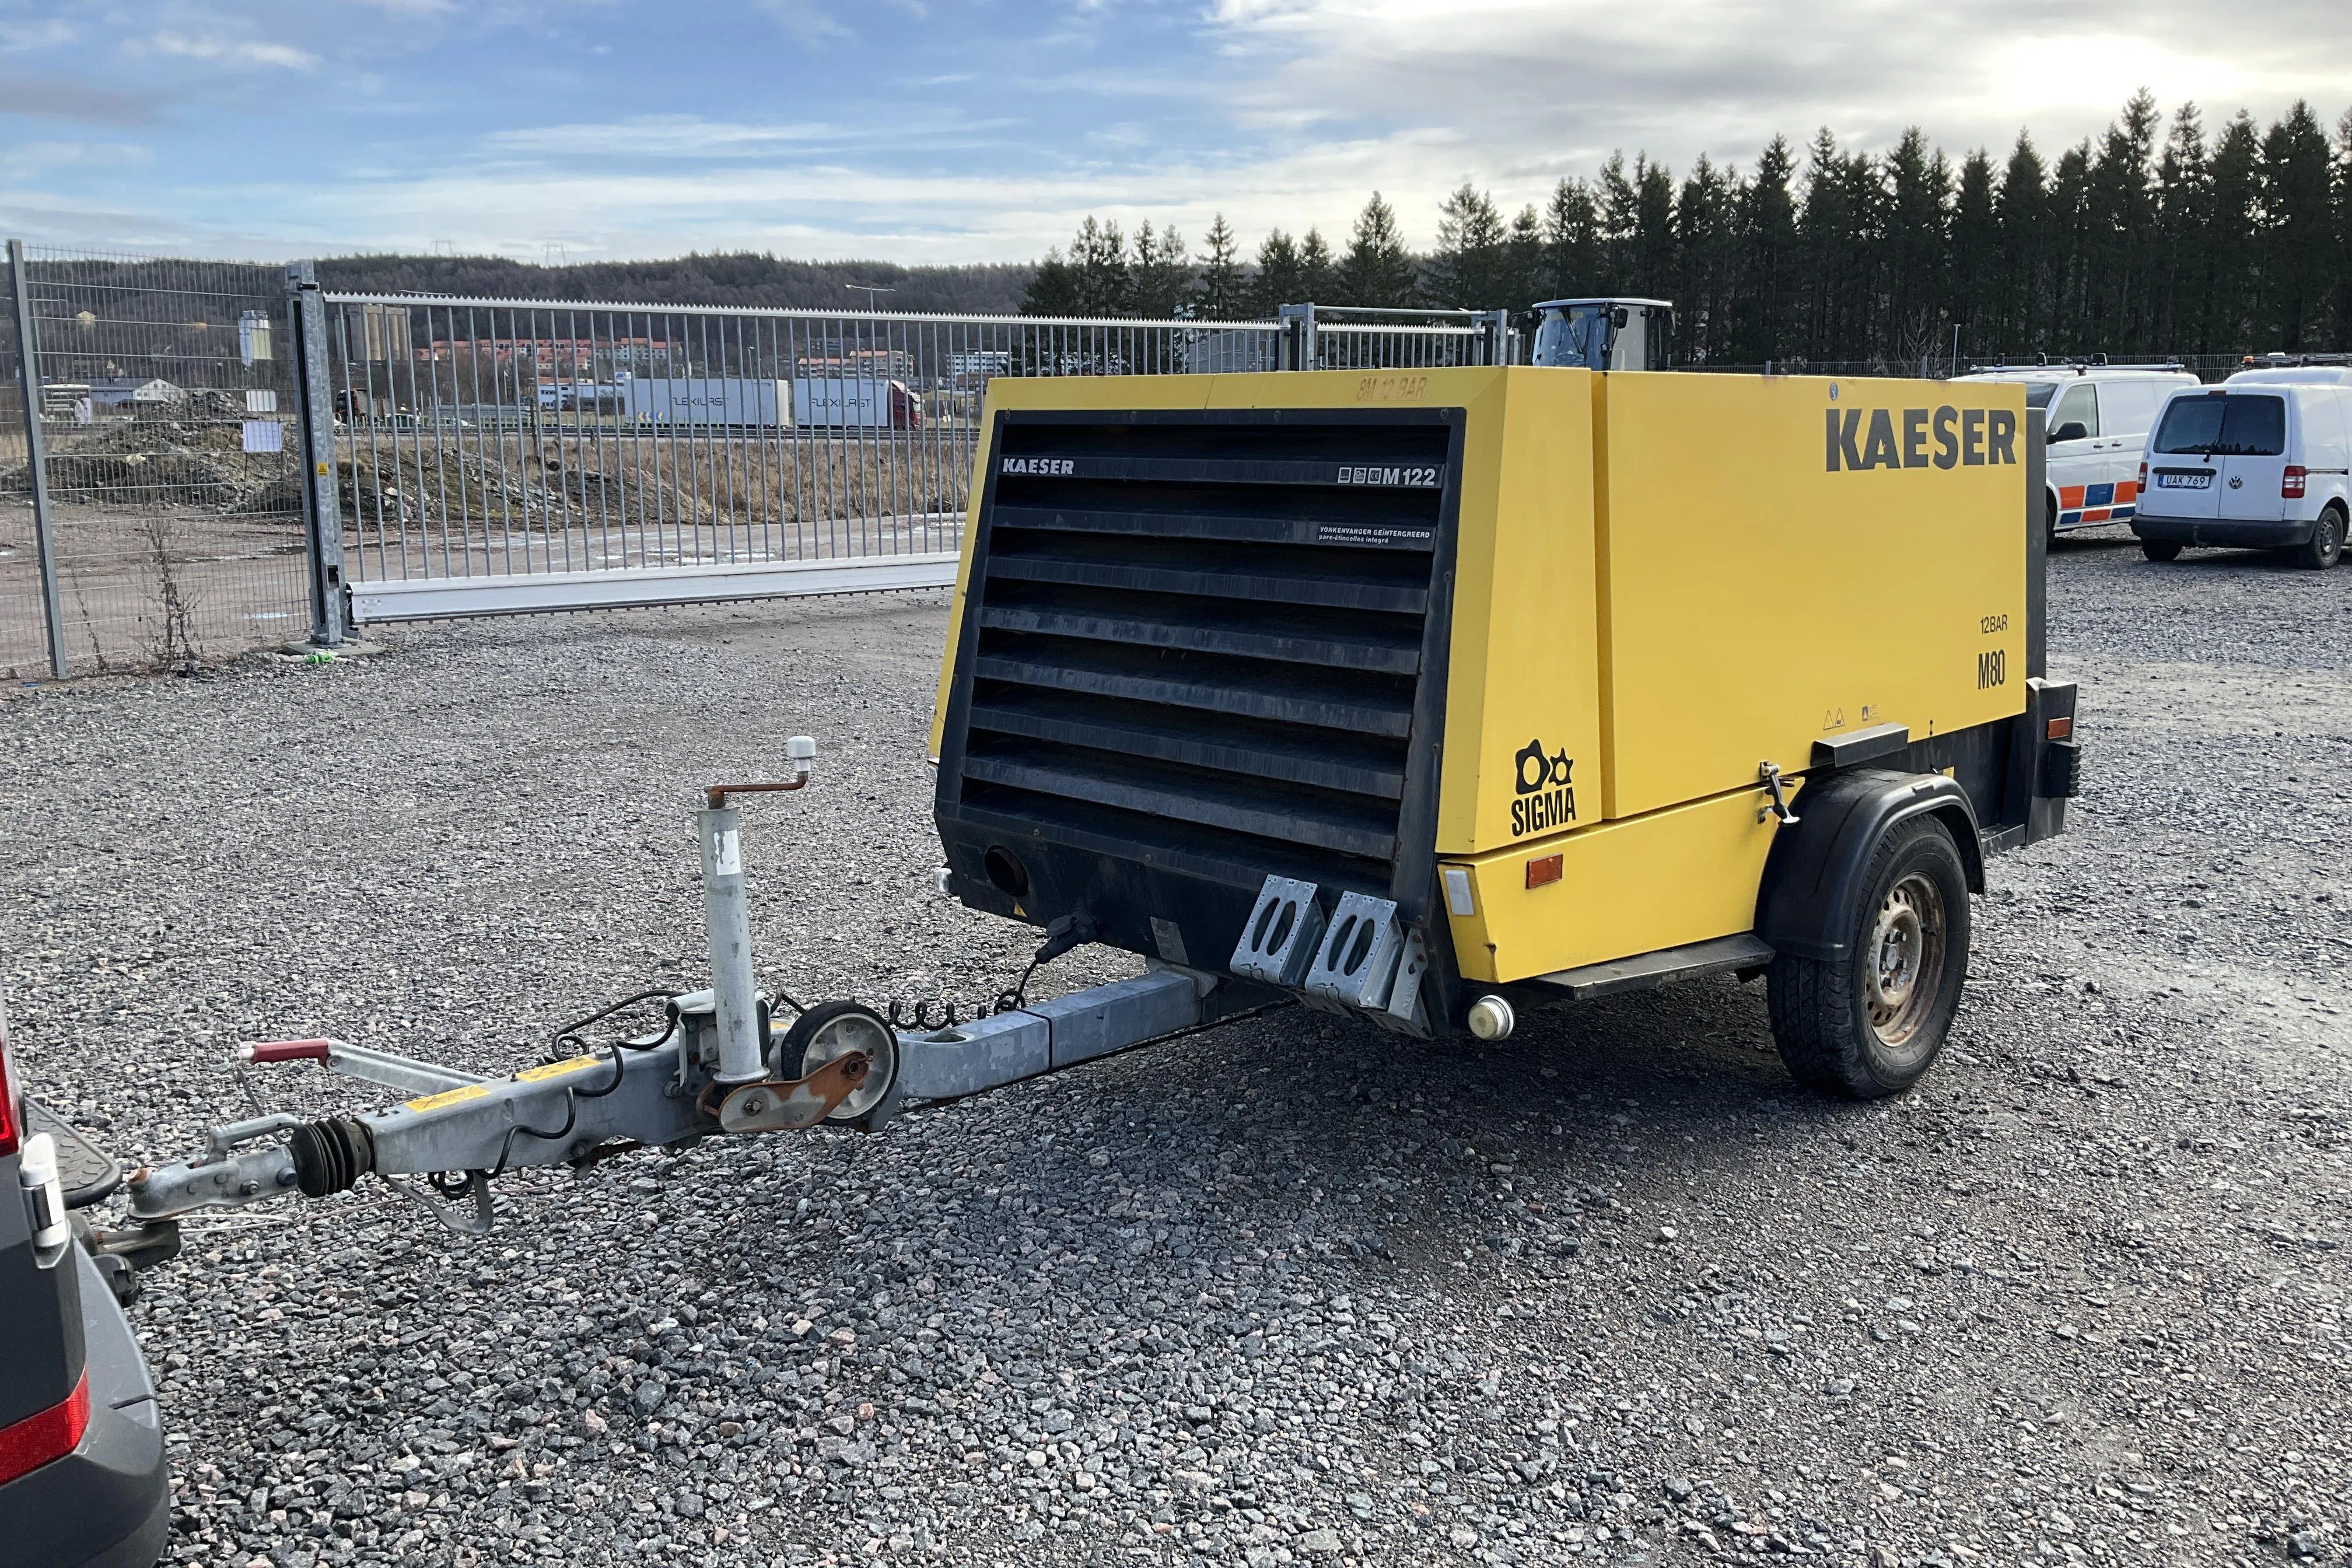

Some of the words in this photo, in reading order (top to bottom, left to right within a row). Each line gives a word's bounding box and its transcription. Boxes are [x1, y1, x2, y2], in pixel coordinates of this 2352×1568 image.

[1381, 378, 1394, 400] 12
[1826, 405, 2016, 472] KAESER
[1003, 458, 1074, 474] KAESER
[1382, 468, 1399, 485] M
[1402, 468, 1436, 486] 122
[2166, 475, 2185, 485] UAK
[2187, 476, 2206, 485] 769
[1318, 534, 1364, 542] pare-étincelles
[1320, 526, 1371, 536] VONKENVANGER
[1980, 614, 2008, 634] 12BAR
[1978, 649, 2006, 690] M80
[1511, 786, 1576, 837] SIGMA
